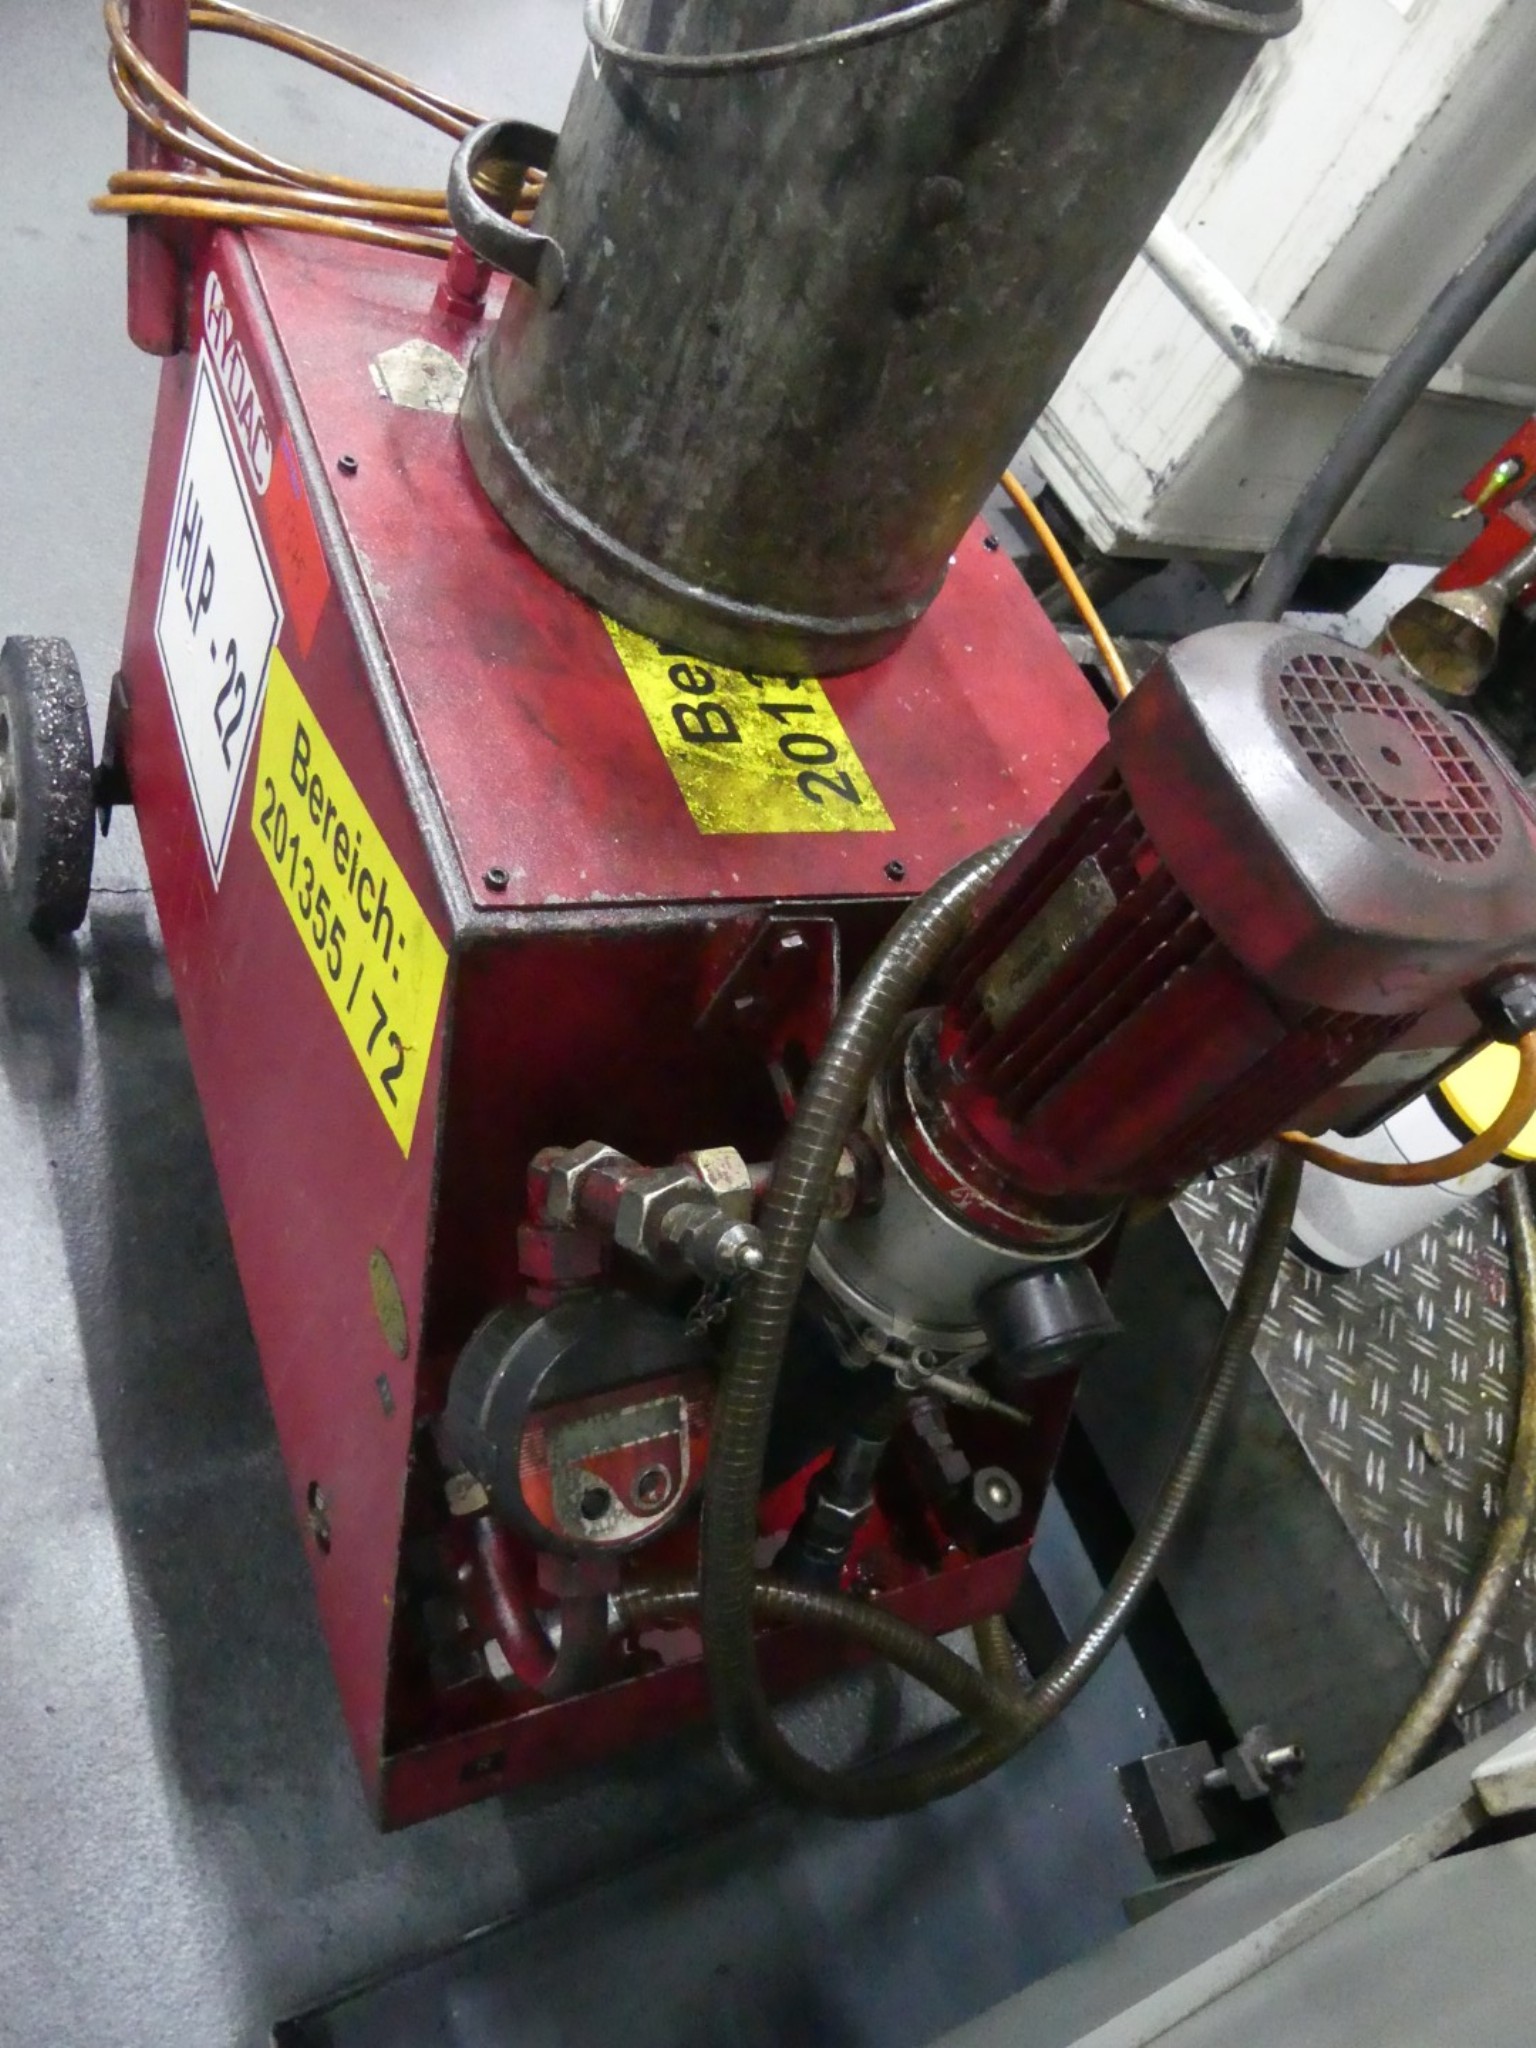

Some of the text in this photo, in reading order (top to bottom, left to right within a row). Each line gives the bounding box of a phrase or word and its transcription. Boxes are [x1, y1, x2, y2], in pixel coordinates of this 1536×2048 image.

[207, 280, 270, 486] HYDAC
[176, 479, 215, 636] HLP
[741, 668, 863, 806] 201
[259, 776, 406, 1108] 201355 / 72
[290, 719, 406, 981] Bereich:
